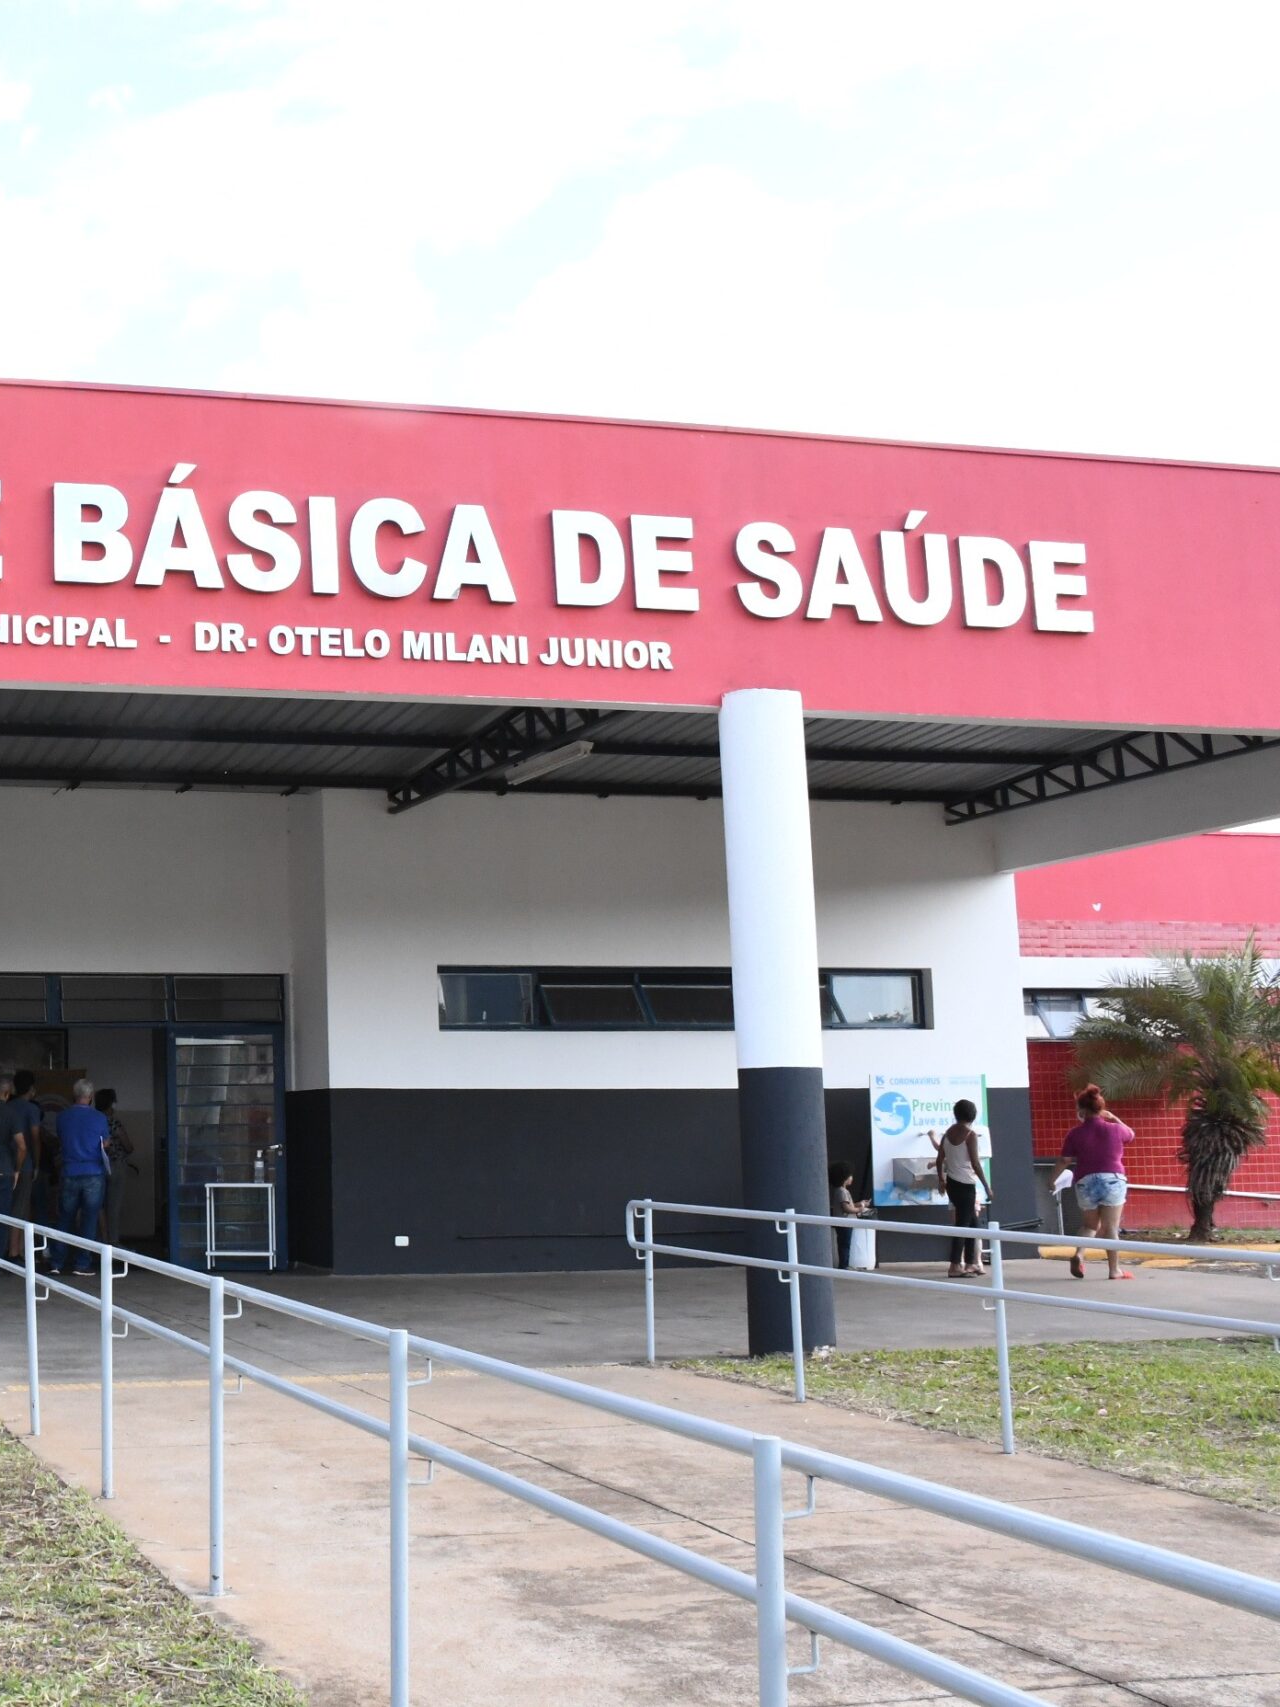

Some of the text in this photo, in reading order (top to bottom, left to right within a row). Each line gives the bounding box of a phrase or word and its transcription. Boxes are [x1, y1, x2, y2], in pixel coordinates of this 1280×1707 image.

[53, 462, 517, 604] BÁSICA
[551, 509, 700, 612] DE
[735, 509, 1095, 634] SAÚDE
[268, 624, 391, 659] OTELO
[403, 630, 529, 666] MILANI
[539, 636, 674, 671] JUNIOR
[913, 1116, 936, 1126] Lave
[938, 1117, 949, 1126] as
